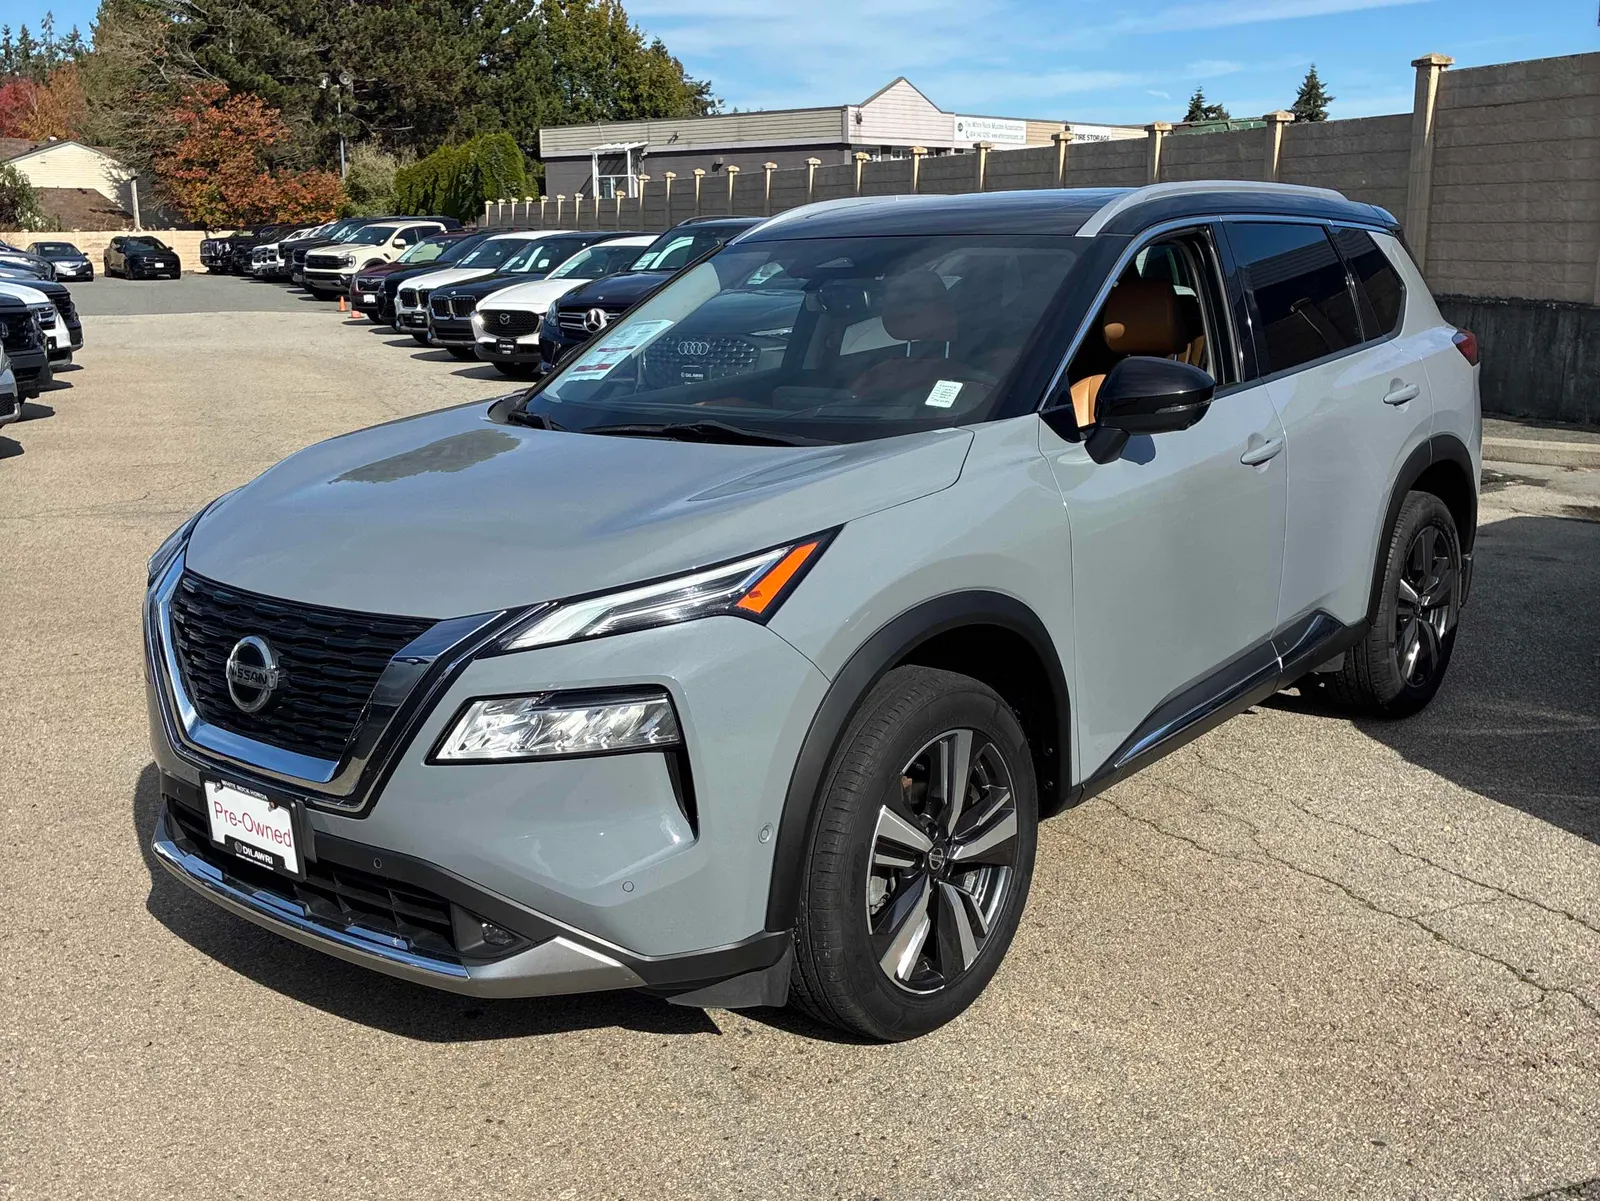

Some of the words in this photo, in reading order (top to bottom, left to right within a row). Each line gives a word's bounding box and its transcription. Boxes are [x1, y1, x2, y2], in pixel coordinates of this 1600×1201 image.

[1075, 133, 1086, 141] TIRE
[230, 661, 268, 684] NISSAN
[214, 800, 292, 848] Pre-Owned
[242, 845, 274, 865] DILAWRI
